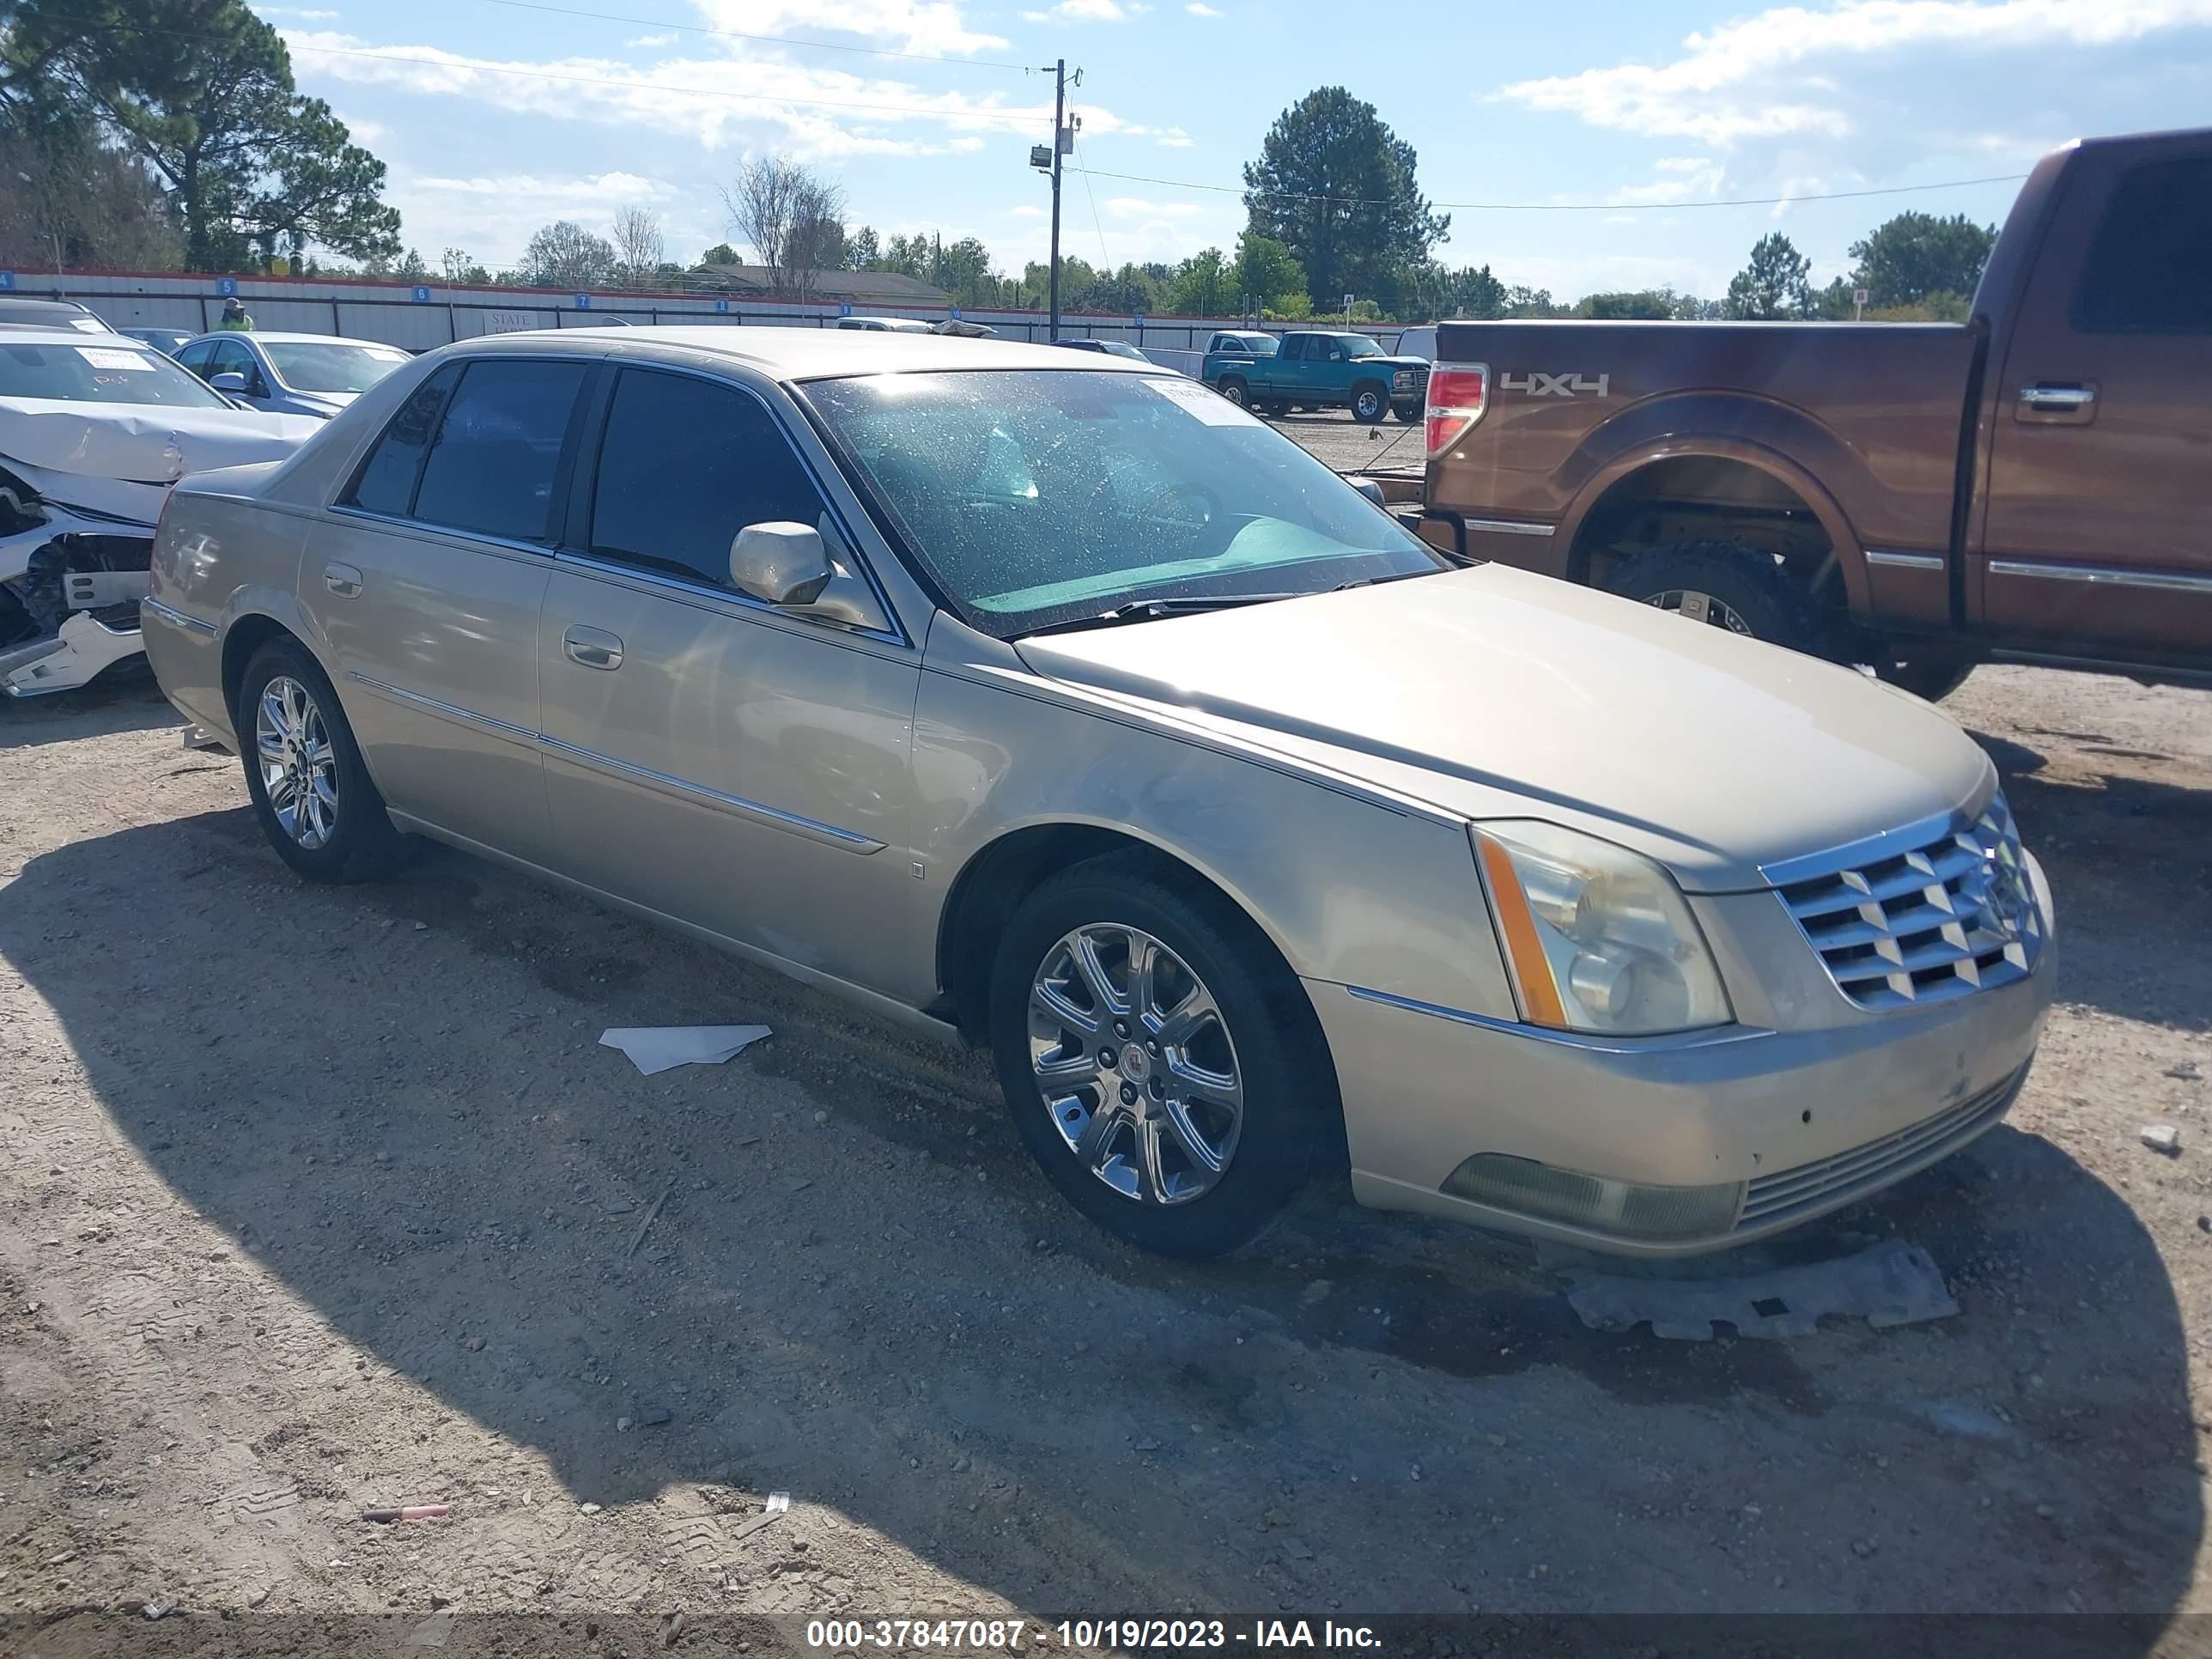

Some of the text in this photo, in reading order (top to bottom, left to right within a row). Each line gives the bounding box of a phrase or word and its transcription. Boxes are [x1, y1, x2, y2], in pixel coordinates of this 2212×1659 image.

[223, 281, 231, 293] 5
[418, 289, 425, 299] 6
[580, 296, 586, 306] 7
[1346, 295, 1352, 304] A
[720, 301, 726, 310] 8
[491, 314, 530, 325] STATE
